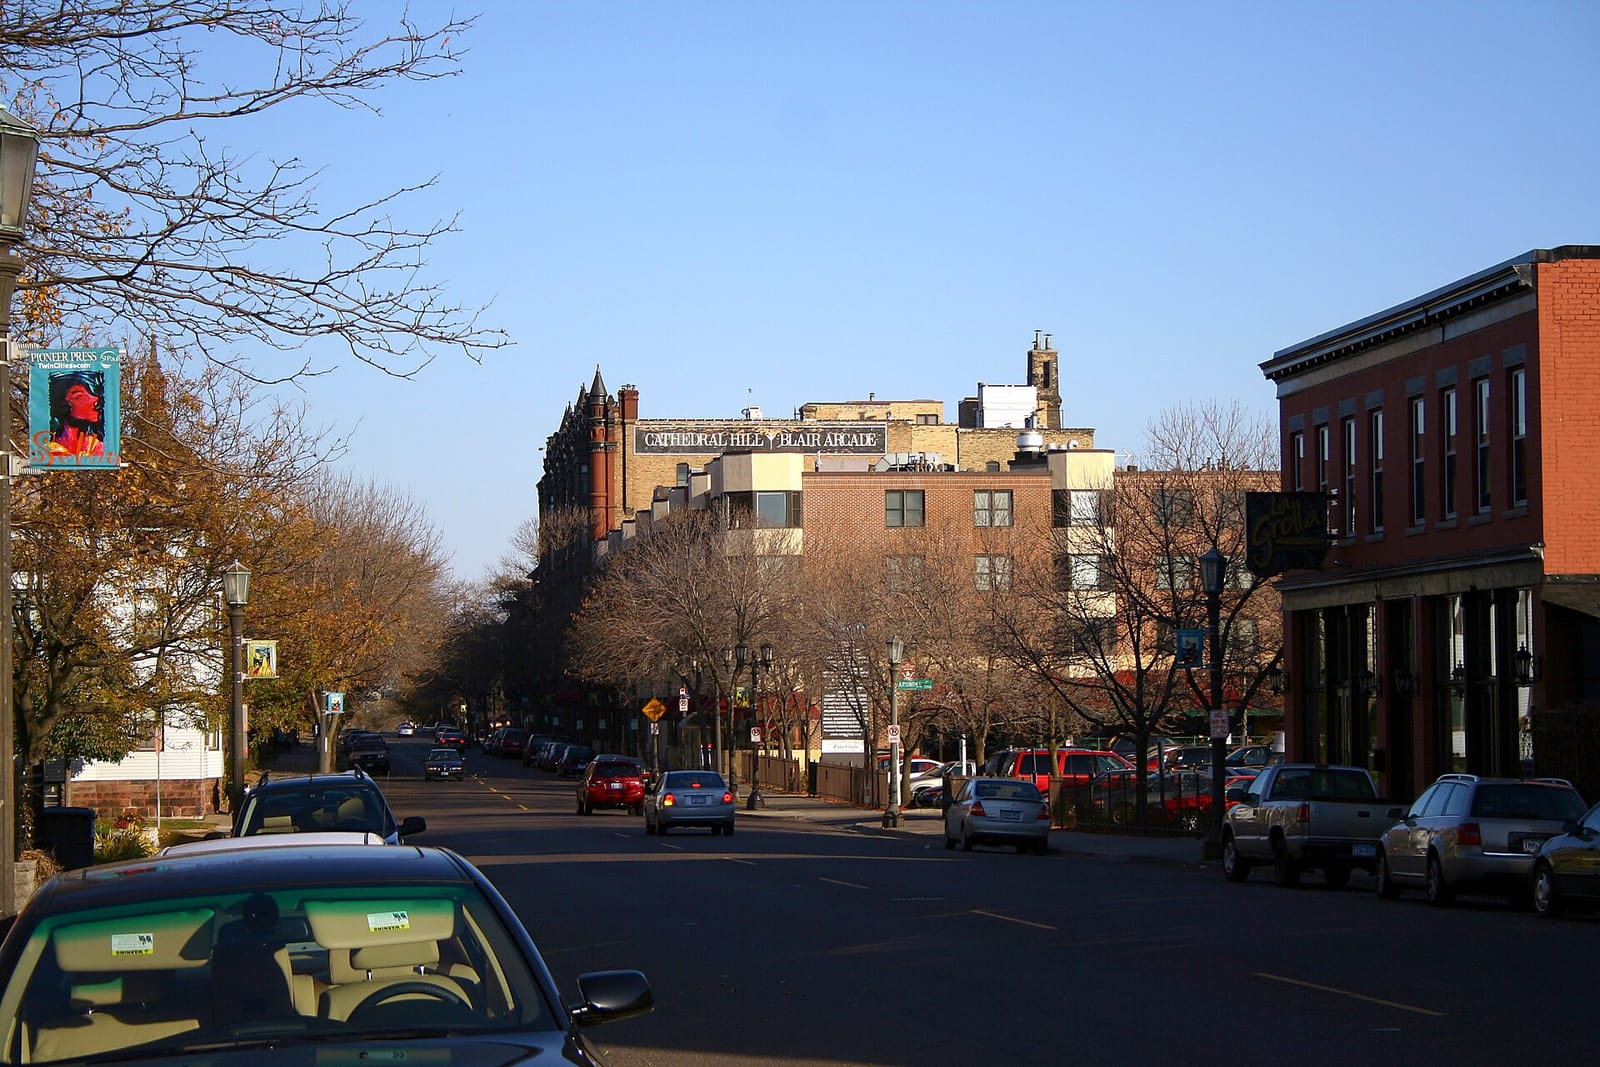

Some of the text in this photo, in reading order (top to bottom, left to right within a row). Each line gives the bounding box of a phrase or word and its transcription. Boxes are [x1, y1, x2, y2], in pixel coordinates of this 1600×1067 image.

[31, 352, 68, 362] PIONEER
[70, 351, 97, 361] PRESS
[644, 431, 877, 448] CATHEDRAL HILL BLAIR ARCADE
